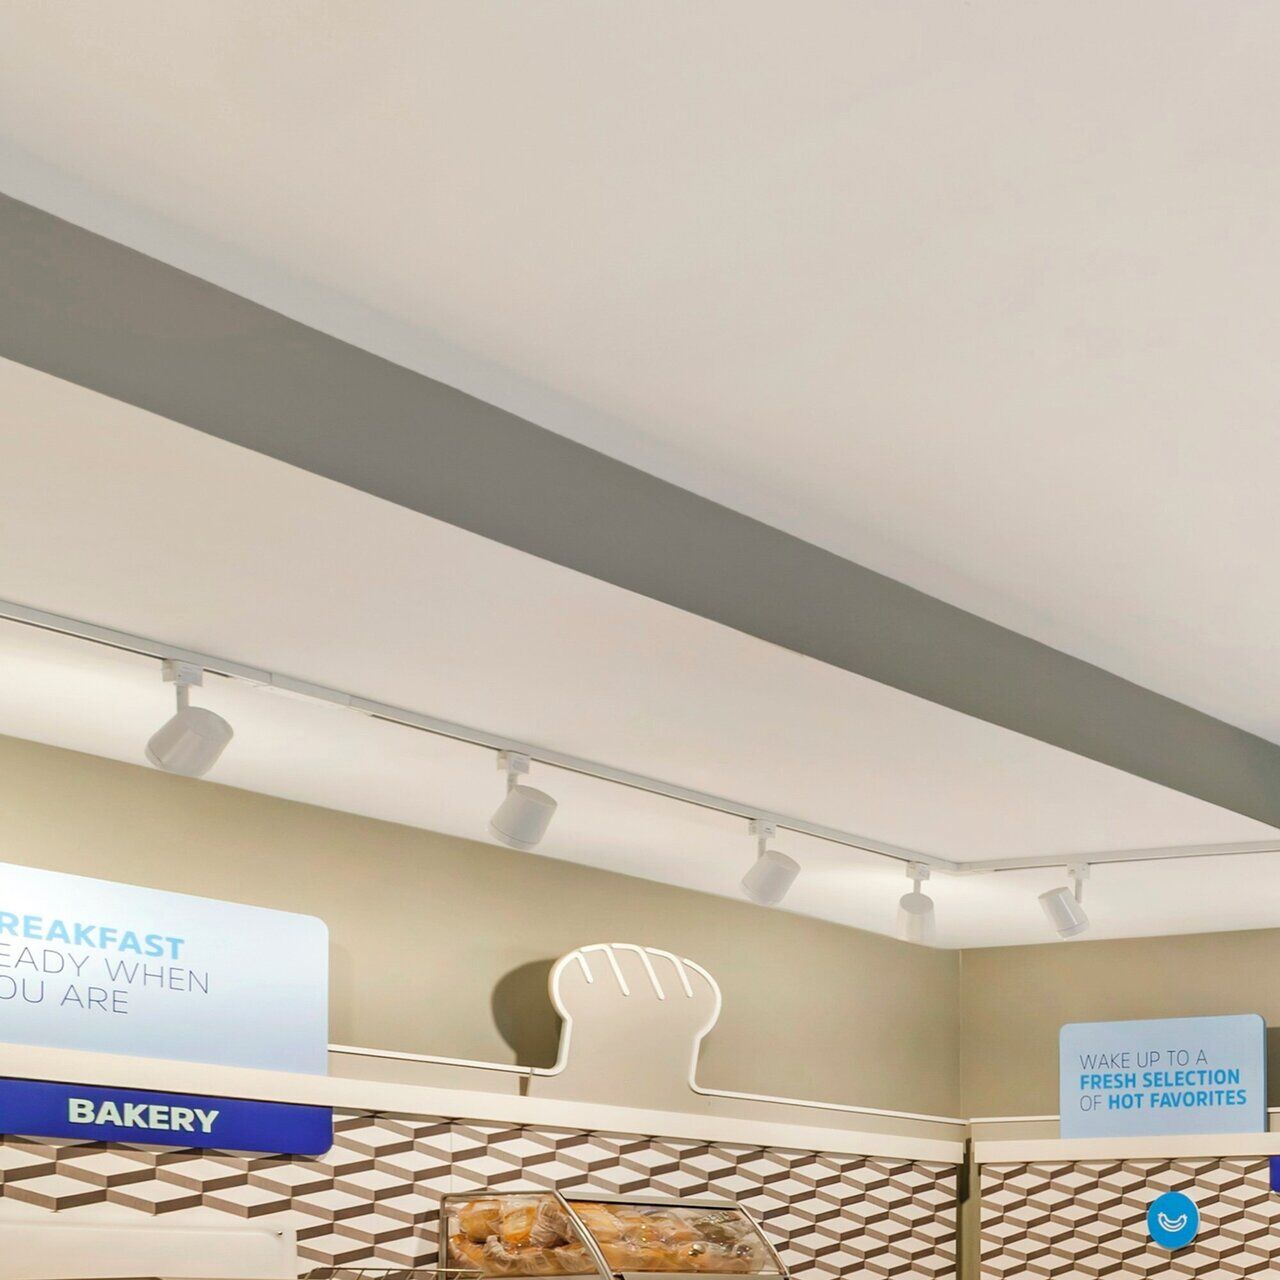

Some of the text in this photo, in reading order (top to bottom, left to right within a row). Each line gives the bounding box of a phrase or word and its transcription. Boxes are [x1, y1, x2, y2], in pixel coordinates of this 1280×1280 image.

[104, 957, 209, 994] WHEN
[60, 984, 129, 1014] ARE
[1079, 1049, 1209, 1070] WAKE UP TO A
[1079, 1069, 1240, 1090] FRESH SELECTION
[1079, 1089, 1248, 1112] OF HOT FAVORITES
[67, 1097, 220, 1134] BAKERY
